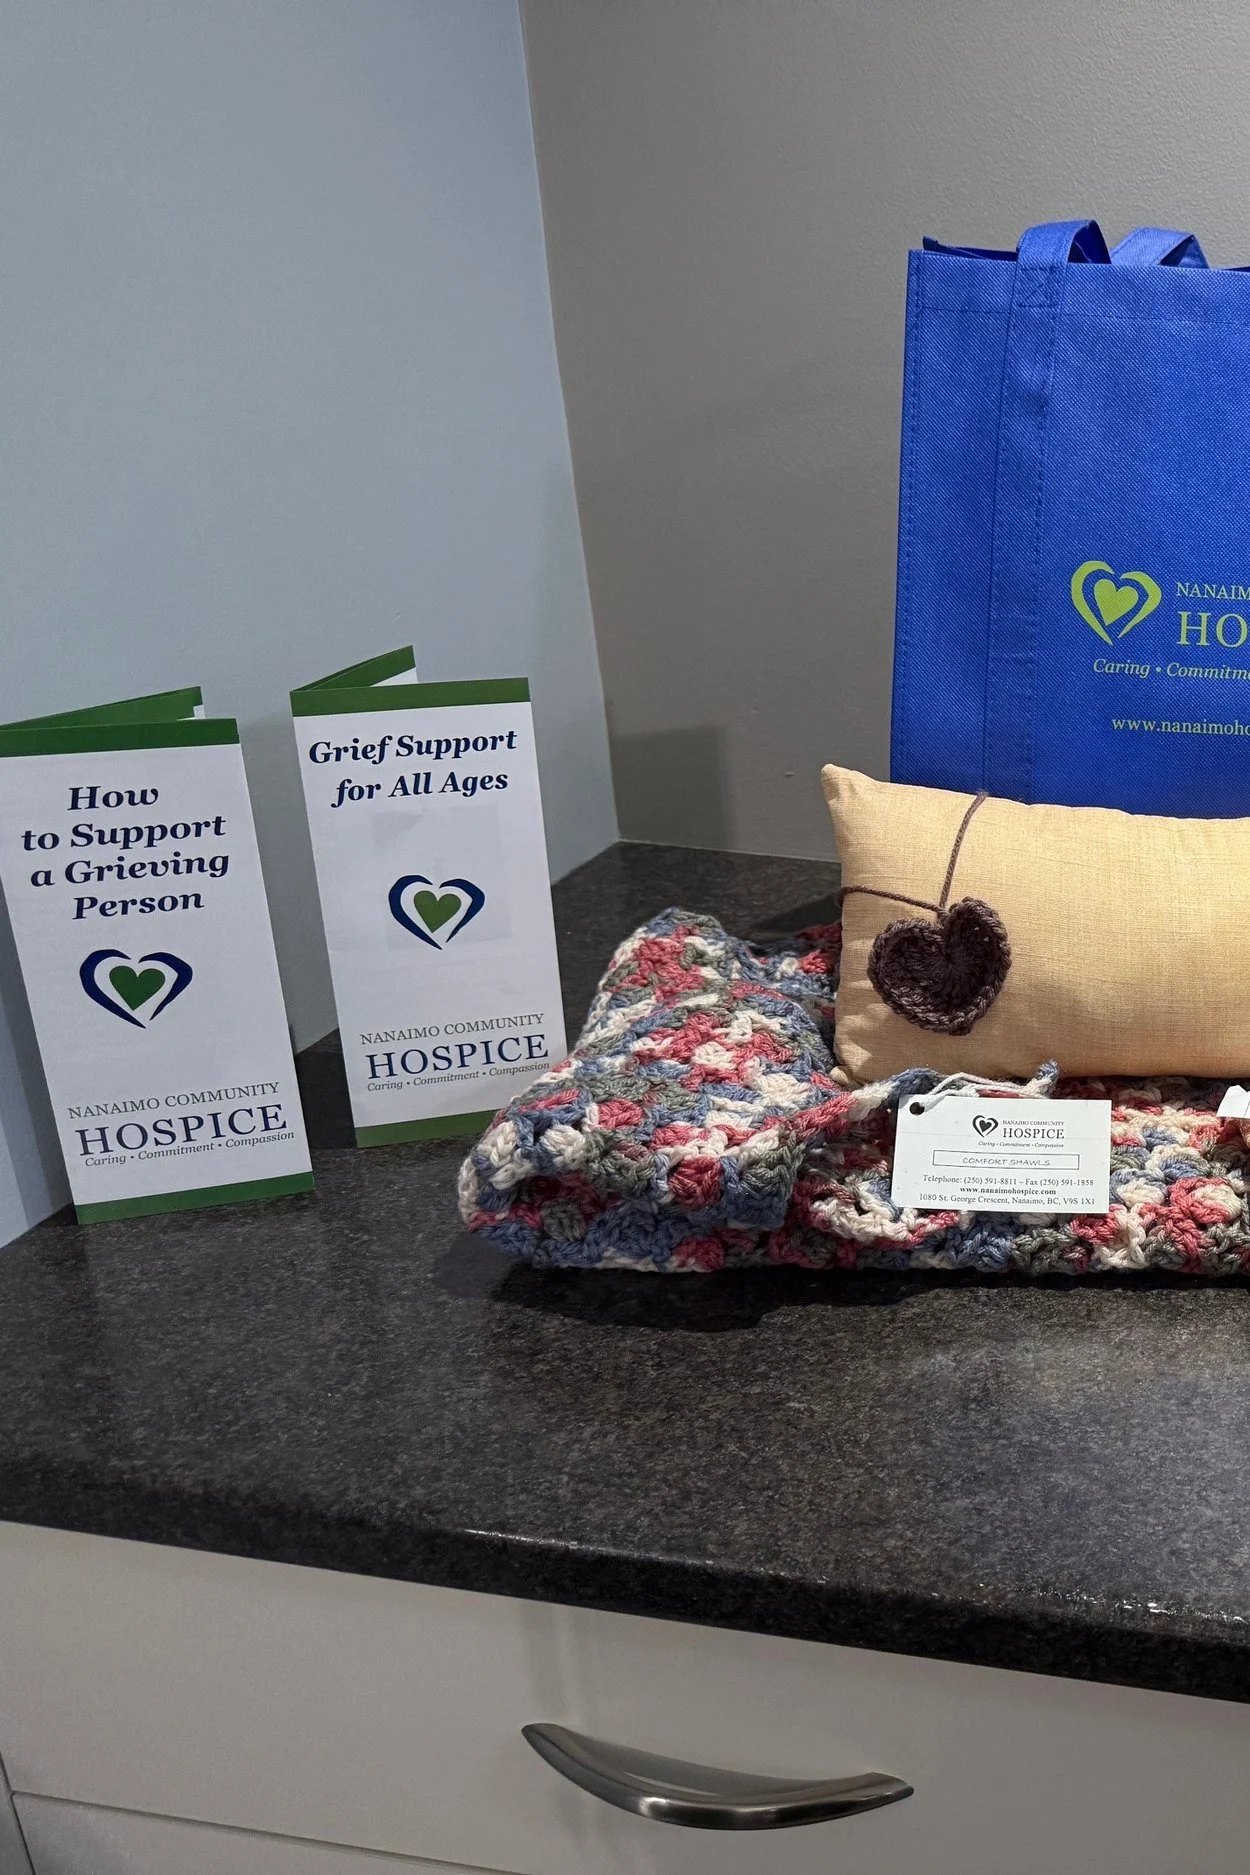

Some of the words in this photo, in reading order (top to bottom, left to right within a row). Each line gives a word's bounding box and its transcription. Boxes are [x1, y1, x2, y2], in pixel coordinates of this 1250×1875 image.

[1093, 658, 1151, 678] Caring
[308, 735, 393, 765] Grief
[396, 729, 518, 761] Support
[67, 784, 159, 811] How
[330, 778, 381, 808] for
[388, 771, 433, 799] All
[439, 770, 509, 800] Ages
[21, 828, 60, 852] to
[70, 815, 227, 851] Support
[30, 866, 55, 887] a
[64, 852, 230, 884] Grieving
[72, 891, 205, 920] Person
[360, 1024, 440, 1045] NANAIMO
[444, 1013, 545, 1036] COMMUNITY
[365, 1034, 549, 1080] HOSPICE
[367, 1079, 404, 1092] Caring
[413, 1070, 480, 1087] Commitment
[488, 1061, 550, 1079] Compassion
[68, 1096, 160, 1120] NANAIMO
[165, 1081, 280, 1108] COMMUNITY
[76, 1103, 288, 1158] HOSPICE
[1002, 1128, 1065, 1139] HOSPICE
[84, 1152, 127, 1168] Caring
[137, 1142, 215, 1161] Commitment
[225, 1130, 295, 1151] Compassion
[963, 1157, 1007, 1165] COMFORT
[1009, 1158, 1051, 1166] SHAWLS
[922, 1174, 962, 1184] Telephone:
[963, 1177, 983, 1185] (250)
[984, 1177, 1017, 1186] 591-8811
[1025, 1178, 1039, 1186] Fax
[1040, 1178, 1059, 1187] (250)
[1061, 1178, 1094, 1187] 591-1858
[960, 1187, 1057, 1196] www.nanaimohospice.com
[919, 1193, 937, 1201] 1080
[939, 1194, 949, 1202] St.
[950, 1194, 976, 1204] George
[977, 1195, 1010, 1204] Crescent,
[1012, 1196, 1046, 1206] Nanaimo,
[1047, 1197, 1061, 1206] BC,
[1062, 1197, 1079, 1205] V9S
[1080, 1197, 1095, 1205] 1X1
